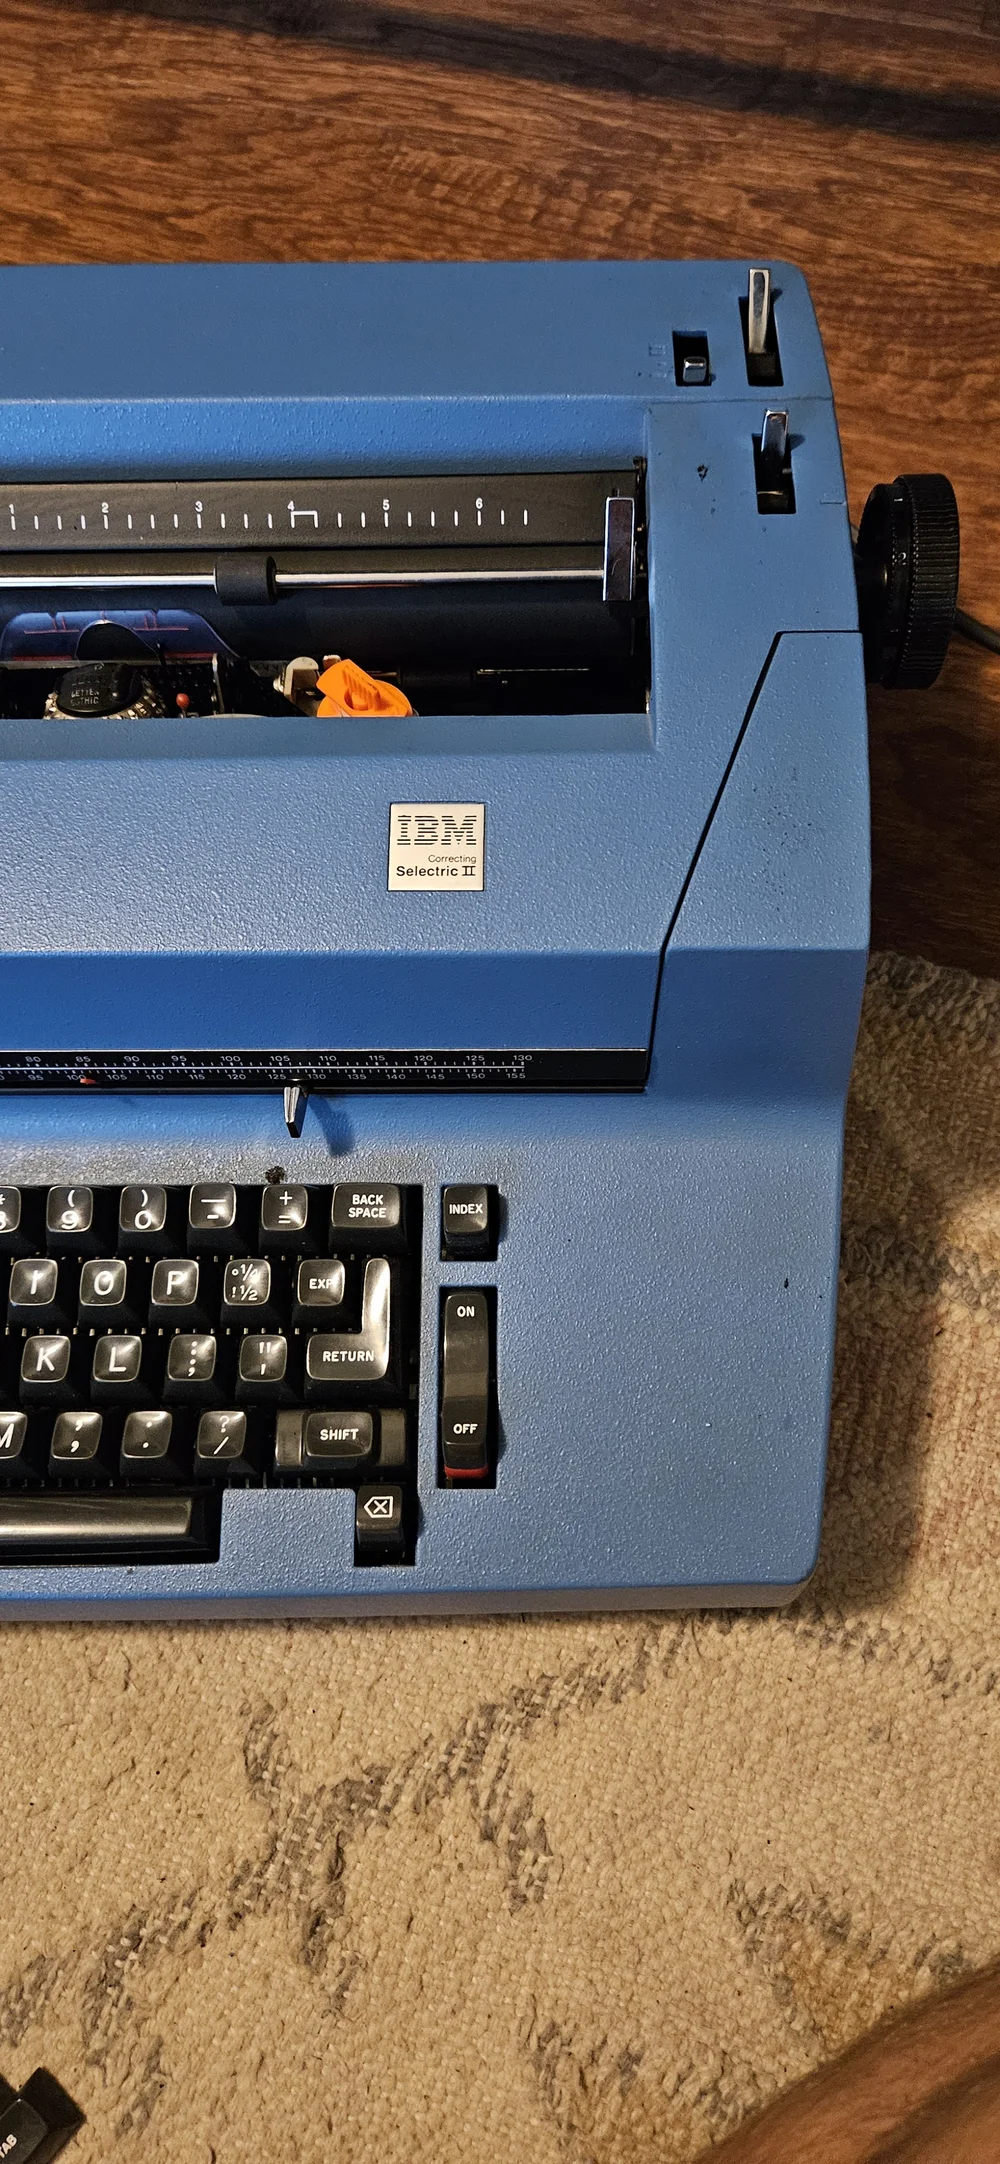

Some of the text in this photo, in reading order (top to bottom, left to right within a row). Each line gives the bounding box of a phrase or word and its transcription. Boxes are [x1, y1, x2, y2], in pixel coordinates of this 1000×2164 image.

[9, 497, 483, 514] 1 2 3 4 5 6
[396, 815, 477, 846] IBM
[428, 854, 477, 864] Correcting
[396, 865, 477, 877] Selectric II
[75, 1055, 91, 1063] 85
[124, 1055, 140, 1063] 90
[513, 1054, 533, 1062] 130
[68, 1189, 75, 1208] (
[141, 1189, 149, 1208] )
[279, 1190, 293, 1206] +
[352, 1194, 384, 1205] BACK
[348, 1207, 387, 1218] SPACE
[449, 1203, 484, 1215] INDEX
[61, 1210, 79, 1230] 9
[278, 1215, 291, 1224] =
[30, 1270, 41, 1295] I
[94, 1270, 114, 1296] O
[166, 1270, 187, 1296] P
[457, 1305, 475, 1318] ON
[36, 1347, 56, 1372] K
[108, 1346, 127, 1372] L
[322, 1350, 374, 1362] RETURN
[219, 1415, 230, 1433] ?
[453, 1423, 479, 1435] OFF
[320, 1428, 359, 1441] SHIFT
[213, 1436, 229, 1455] /
